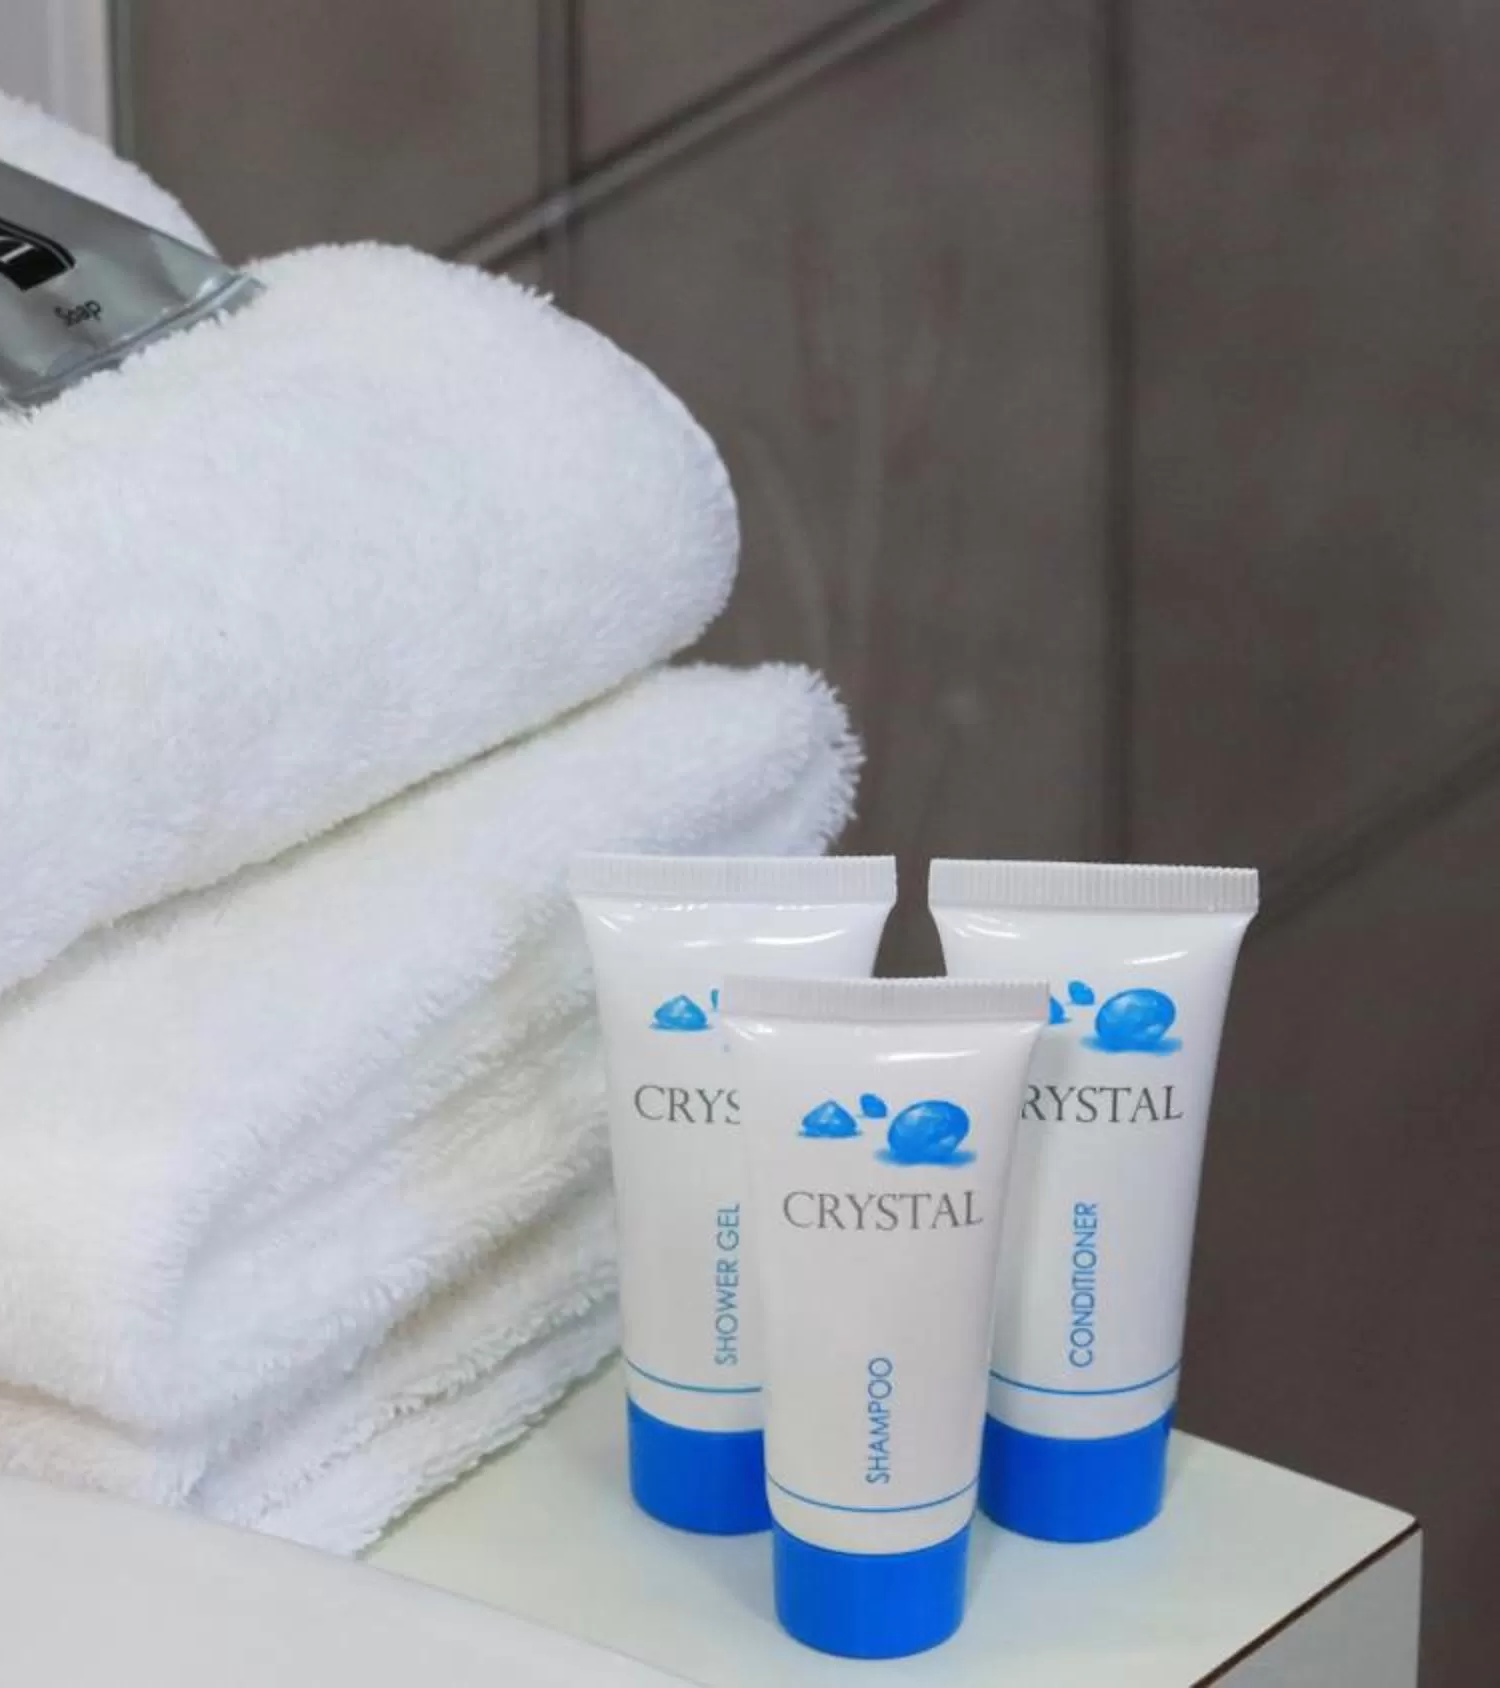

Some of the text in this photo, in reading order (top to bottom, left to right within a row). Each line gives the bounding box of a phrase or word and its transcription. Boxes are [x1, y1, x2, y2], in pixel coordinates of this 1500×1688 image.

[53, 299, 103, 327] Soap
[633, 1083, 741, 1125] CRYS
[1020, 1083, 1186, 1124] RYSTAL
[782, 1189, 985, 1232] CRYSTAL
[713, 1202, 741, 1367] SHOWER GEL
[1068, 1201, 1099, 1369] CONDITIONER
[864, 1356, 894, 1485] SHAMPOO
